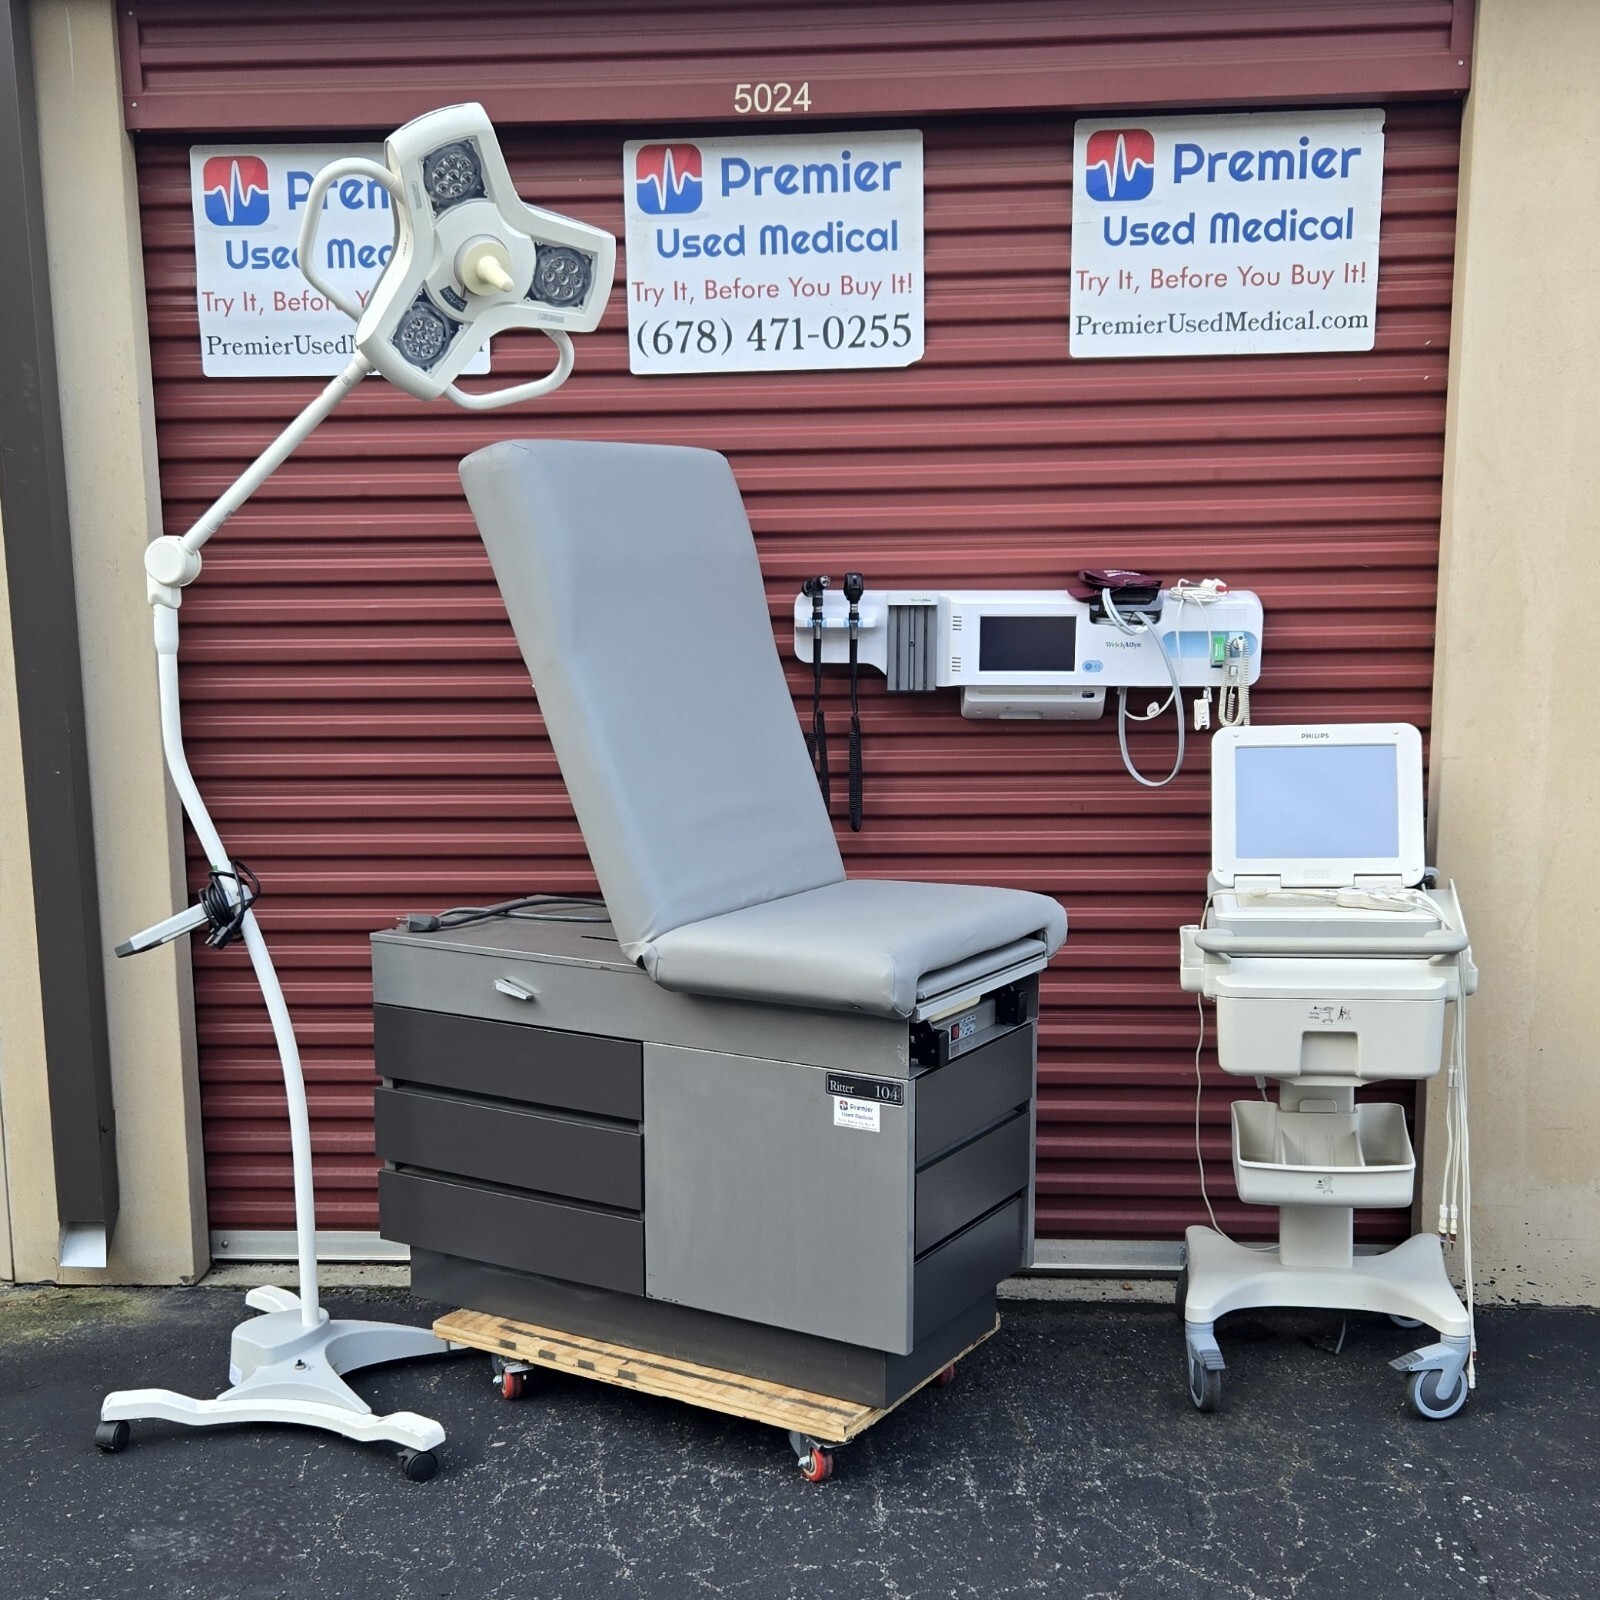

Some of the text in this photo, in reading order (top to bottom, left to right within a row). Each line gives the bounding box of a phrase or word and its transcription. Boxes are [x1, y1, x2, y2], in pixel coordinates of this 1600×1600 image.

[734, 82, 811, 113] 5024
[721, 150, 902, 197] Premier
[1173, 136, 1362, 184] Premier
[656, 220, 898, 259] Used Medical
[1104, 207, 1354, 246] Used Medical
[226, 240, 301, 269] Use
[632, 273, 913, 307] Try It, Before You Buy It!
[1075, 262, 1367, 296] Try It, Before You Buy It!
[201, 291, 235, 317] Try
[243, 290, 264, 316] It,
[273, 289, 343, 311] Befor
[636, 313, 912, 358] (678) 471-0255
[1075, 310, 1369, 335] PremierUsedMedical.com
[1300, 732, 1330, 740] PHILIPS
[829, 1080, 900, 1101] Ritter 104
